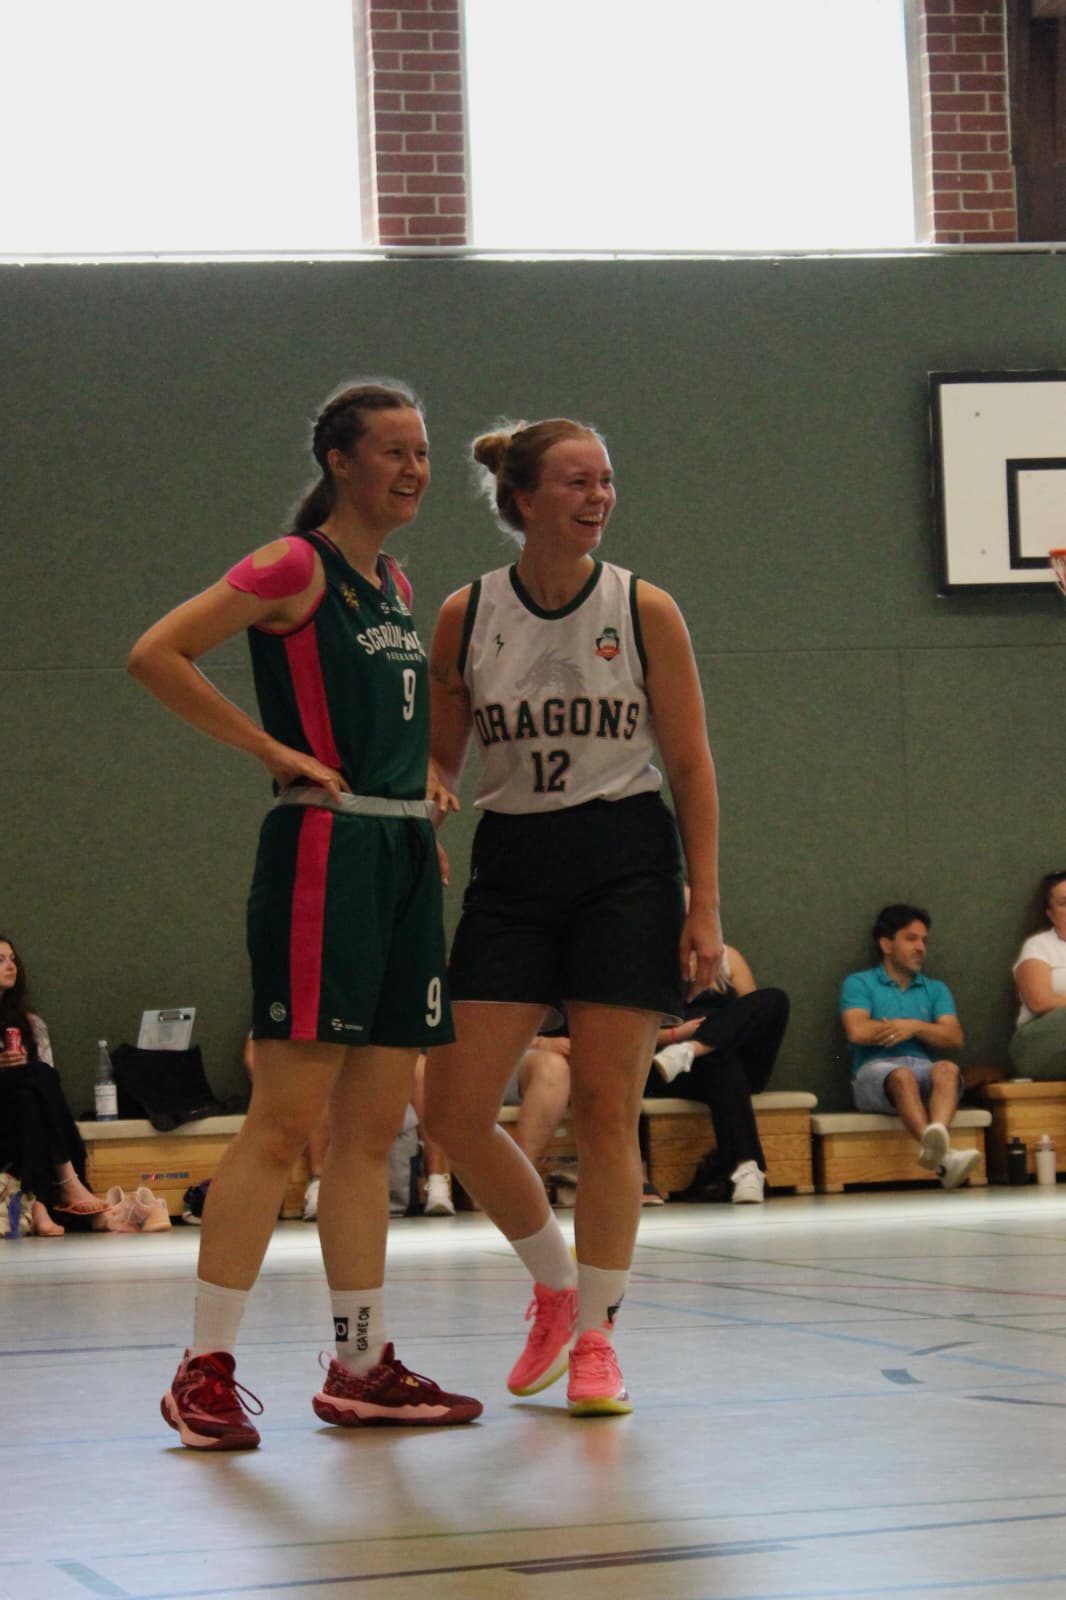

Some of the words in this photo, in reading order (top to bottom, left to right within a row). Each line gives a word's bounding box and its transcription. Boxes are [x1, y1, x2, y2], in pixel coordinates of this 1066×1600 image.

[403, 668, 416, 721] 9
[474, 696, 639, 746] DRAGONS
[531, 749, 570, 792] 12
[425, 976, 442, 1027] 9
